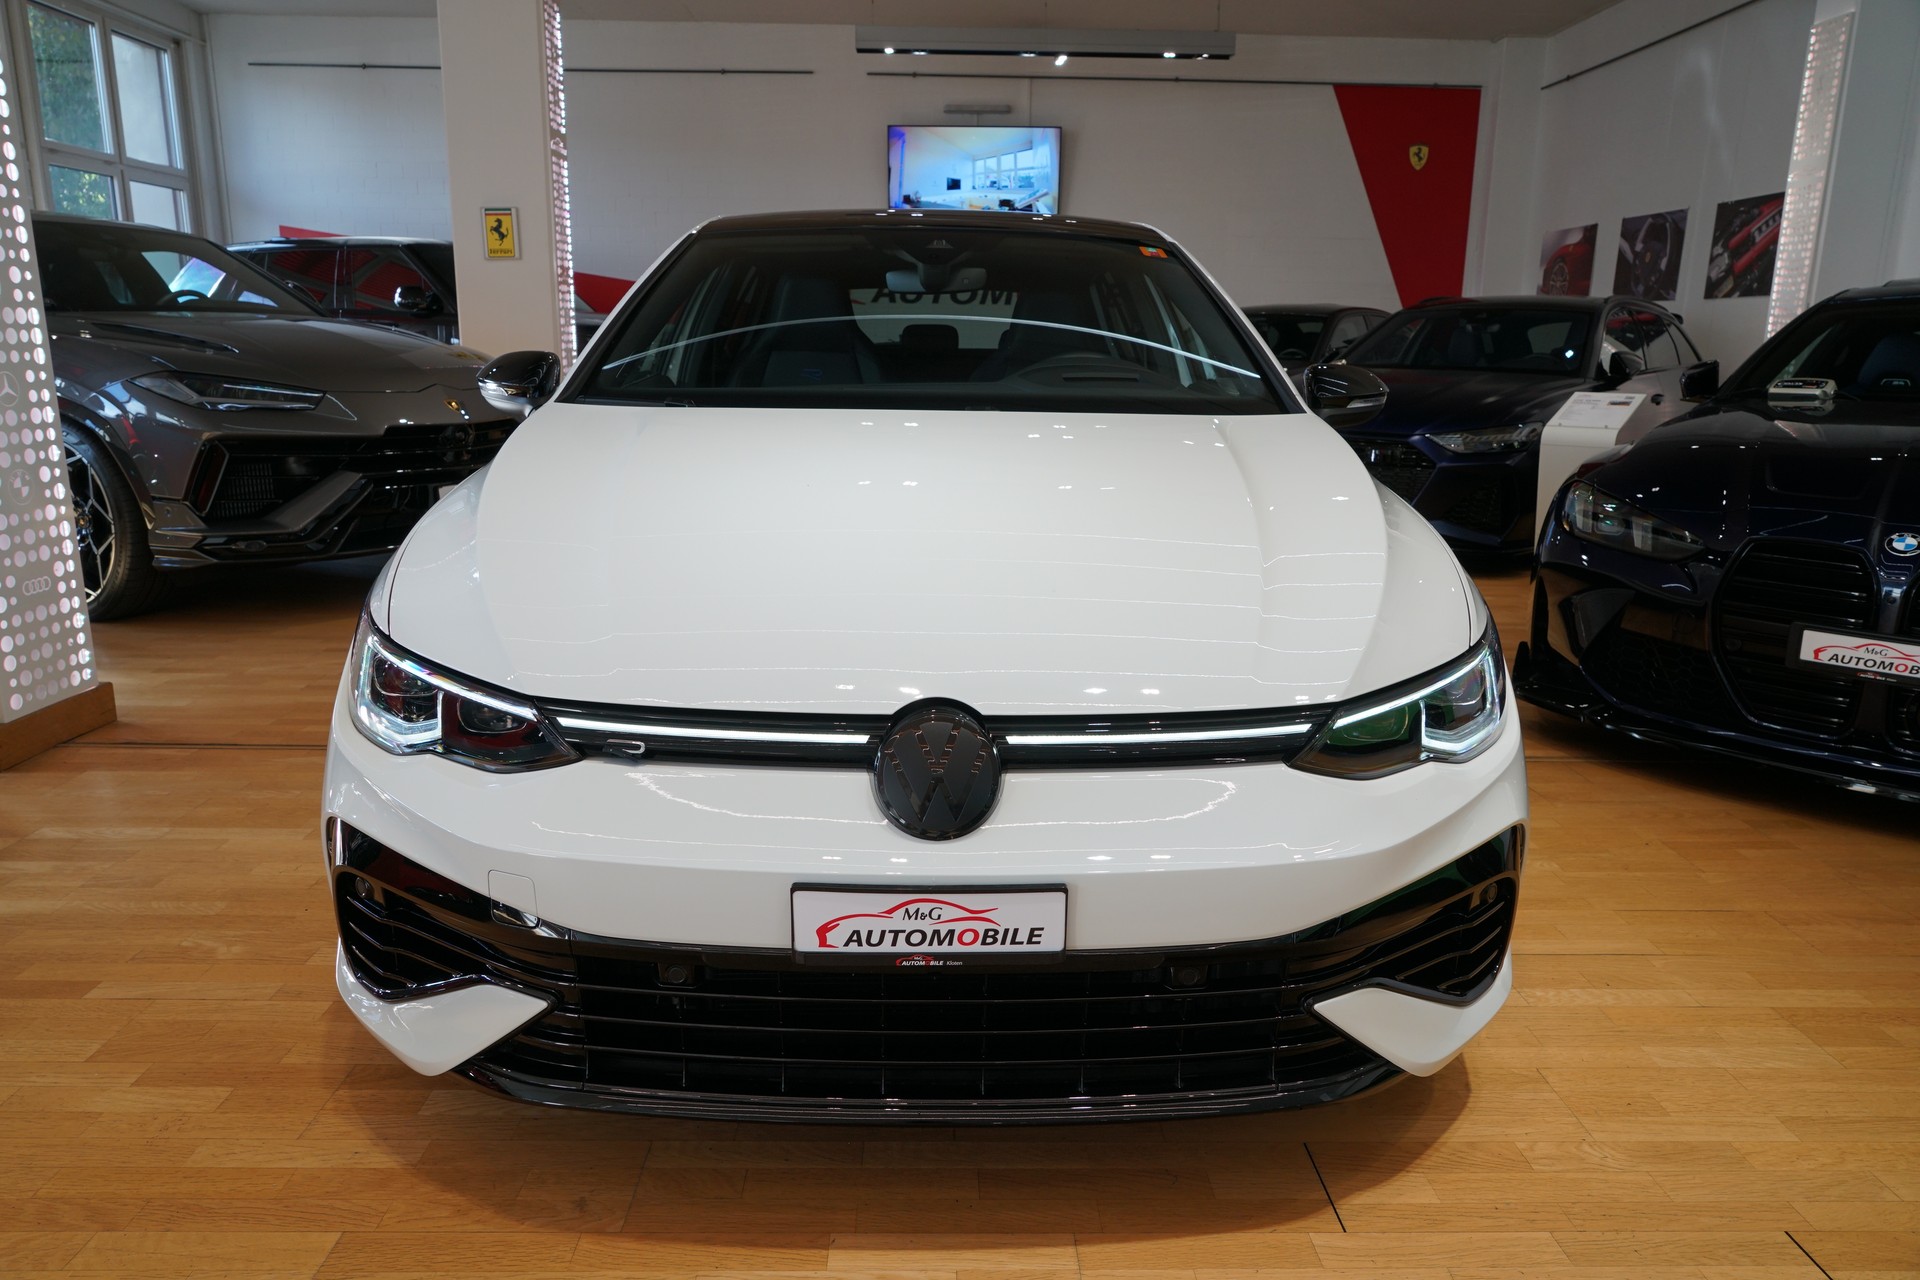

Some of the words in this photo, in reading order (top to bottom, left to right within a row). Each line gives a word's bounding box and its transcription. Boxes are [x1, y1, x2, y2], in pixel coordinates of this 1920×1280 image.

[1864, 646, 1889, 657] M&G
[902, 906, 943, 921] M&G
[843, 927, 1045, 947] AUTOMOBILE
